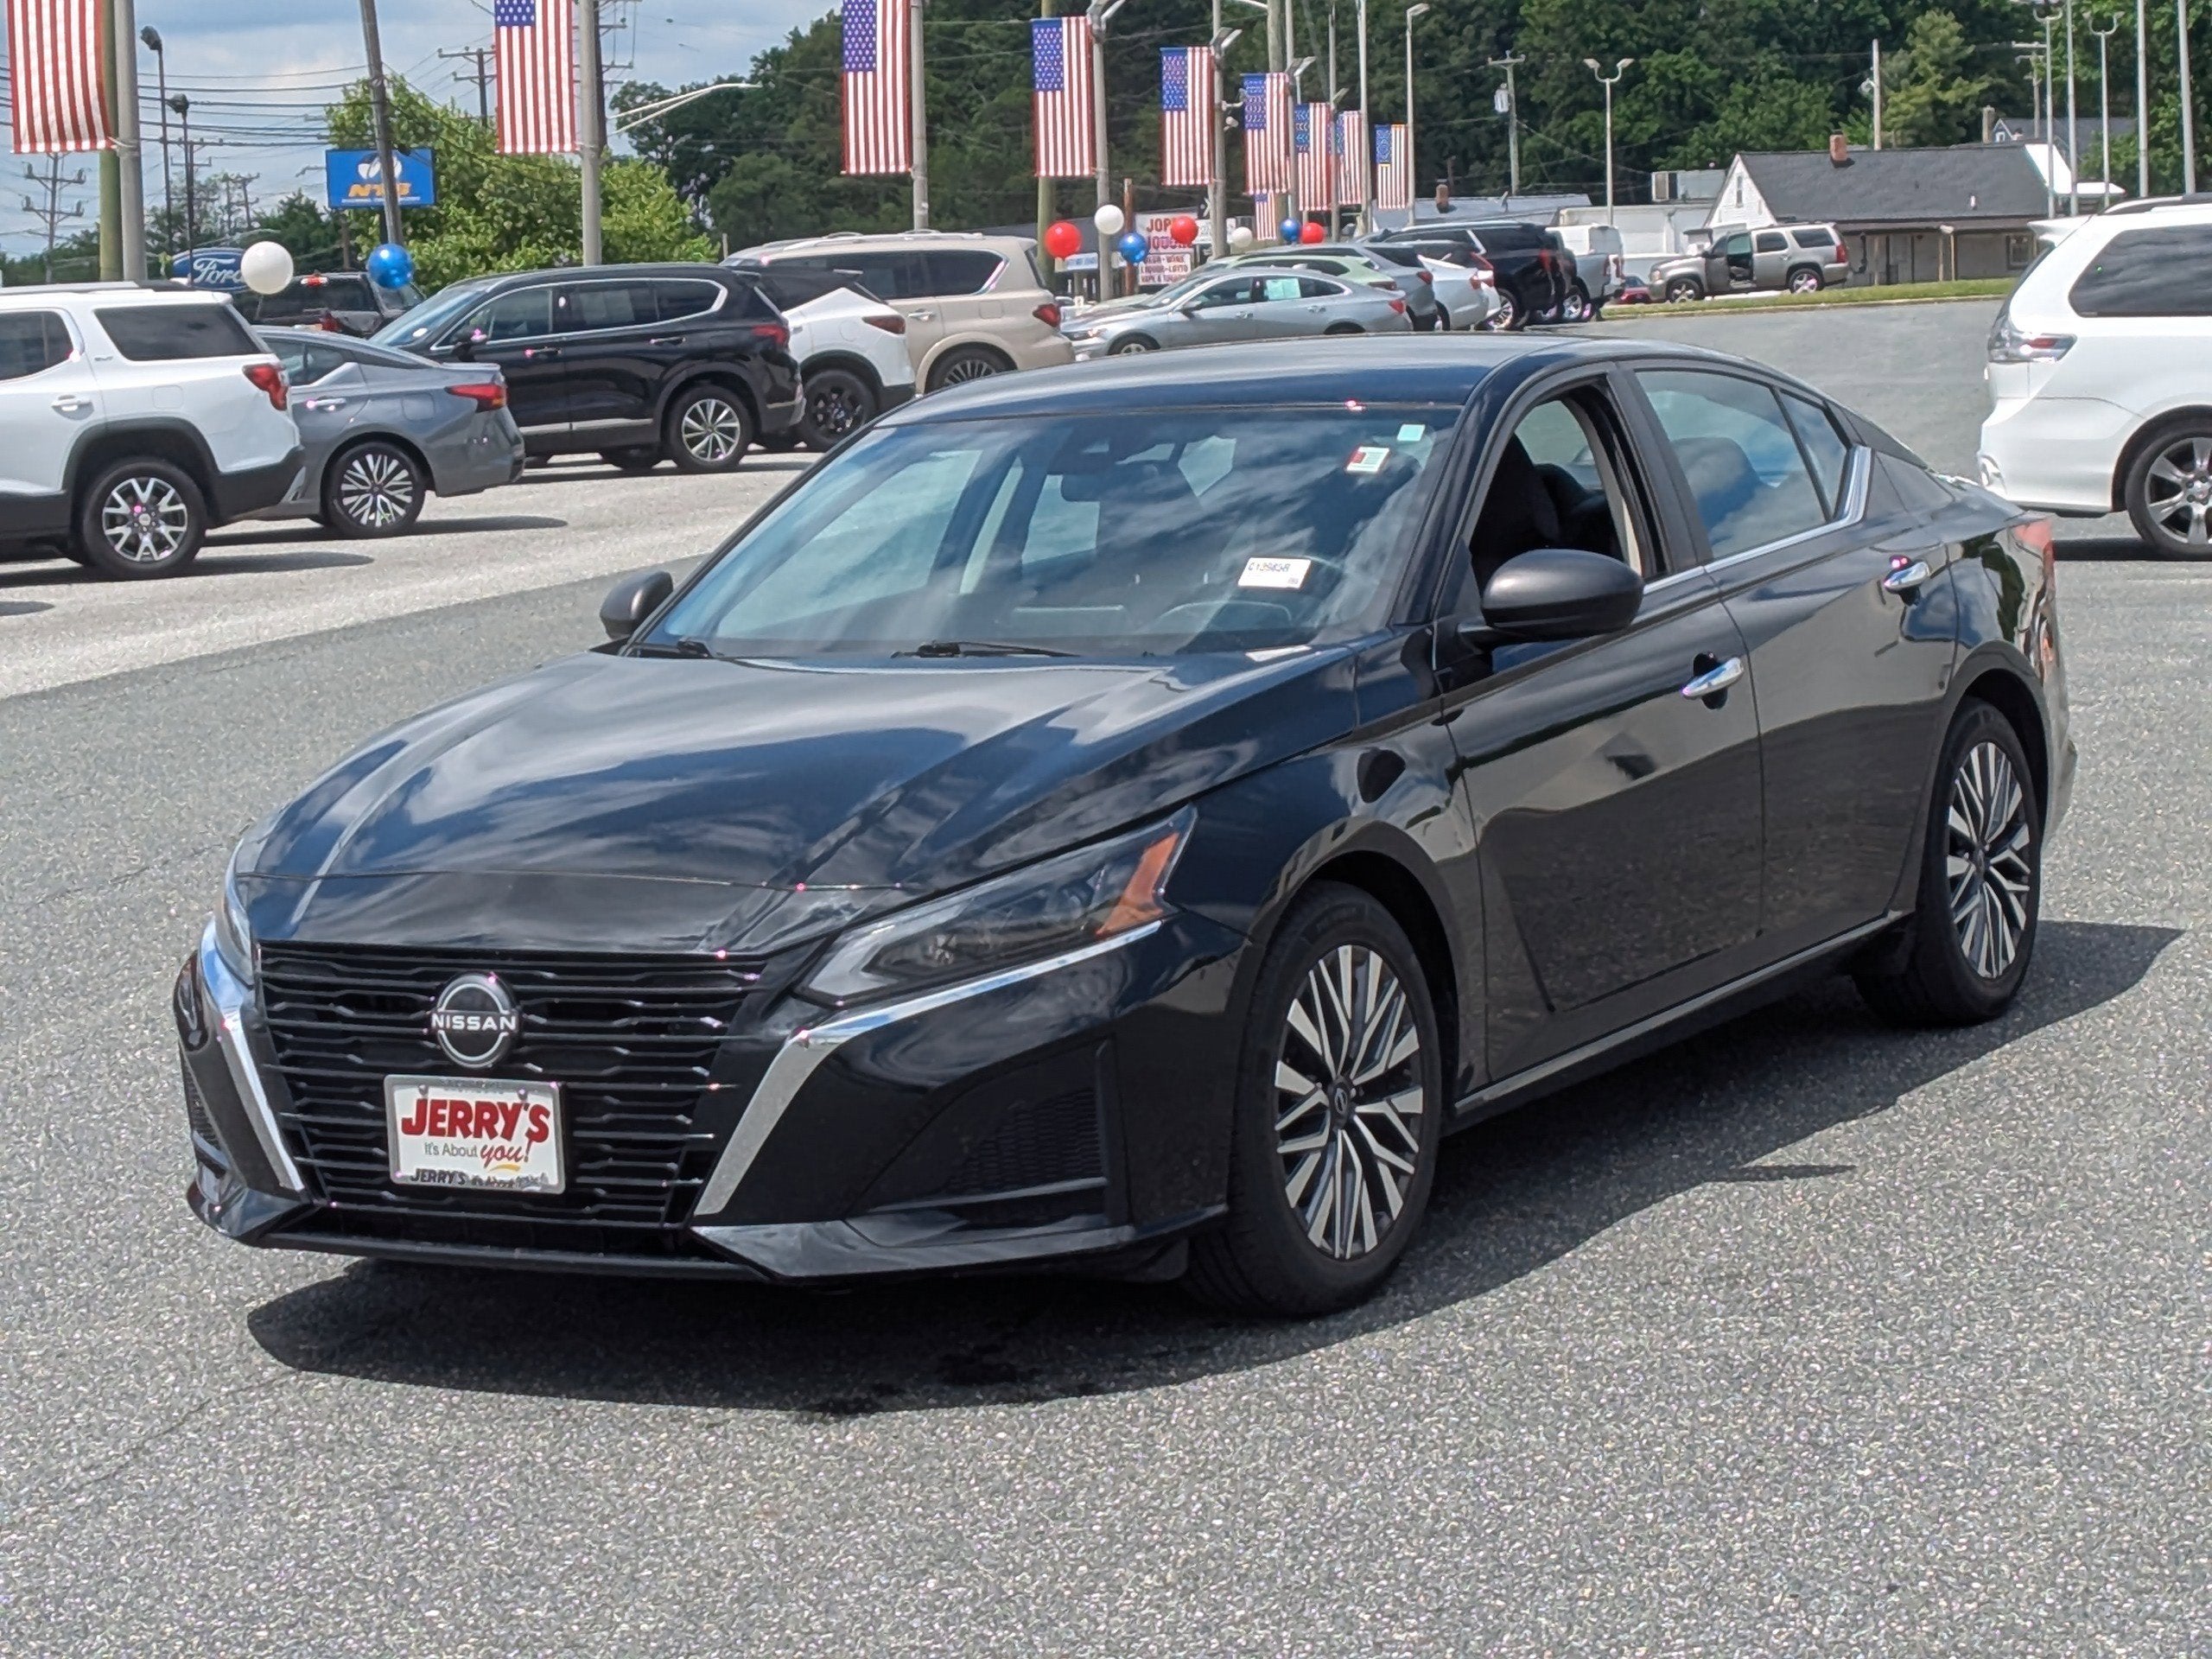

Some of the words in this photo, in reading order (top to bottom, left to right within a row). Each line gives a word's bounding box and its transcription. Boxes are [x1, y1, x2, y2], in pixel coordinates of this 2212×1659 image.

[432, 1014, 516, 1031] NISSAN
[401, 1098, 550, 1142] JERRY'S
[424, 1142, 440, 1156] It's
[442, 1143, 479, 1158] About
[480, 1140, 532, 1168] you!
